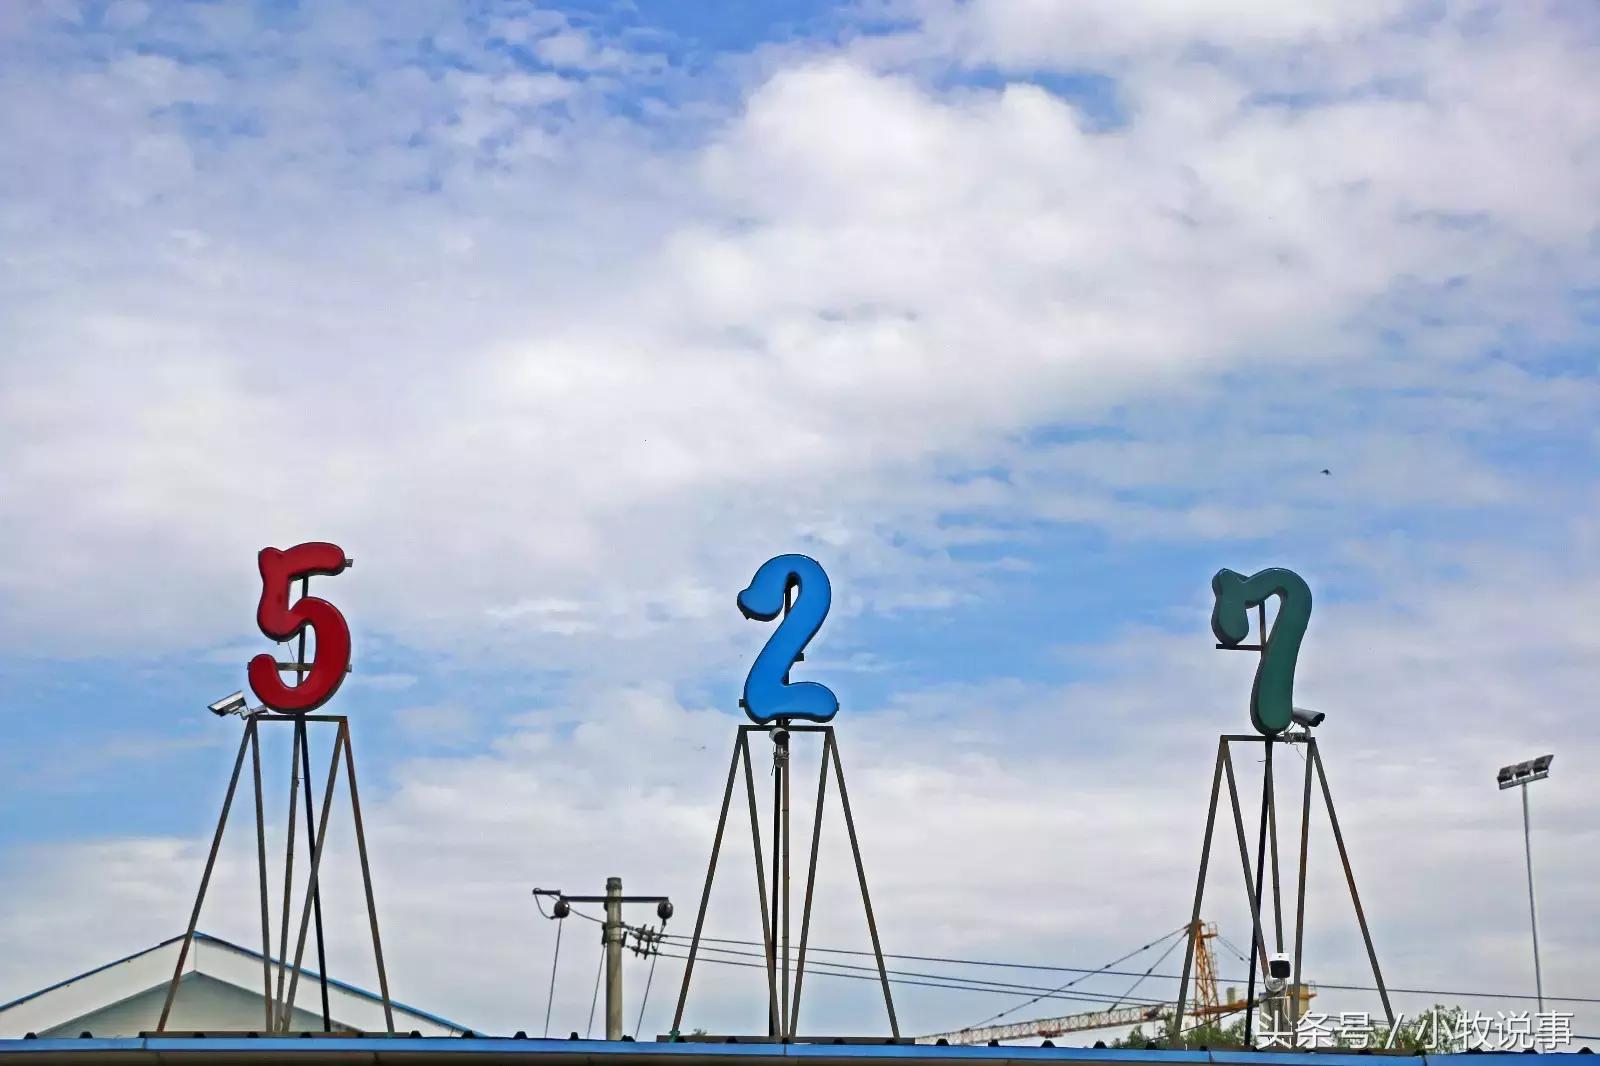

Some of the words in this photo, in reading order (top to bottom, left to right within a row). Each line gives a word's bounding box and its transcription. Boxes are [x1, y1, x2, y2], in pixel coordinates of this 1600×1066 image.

[248, 542, 351, 714] 5
[737, 554, 838, 725] 2
[1211, 567, 1312, 736] 7
